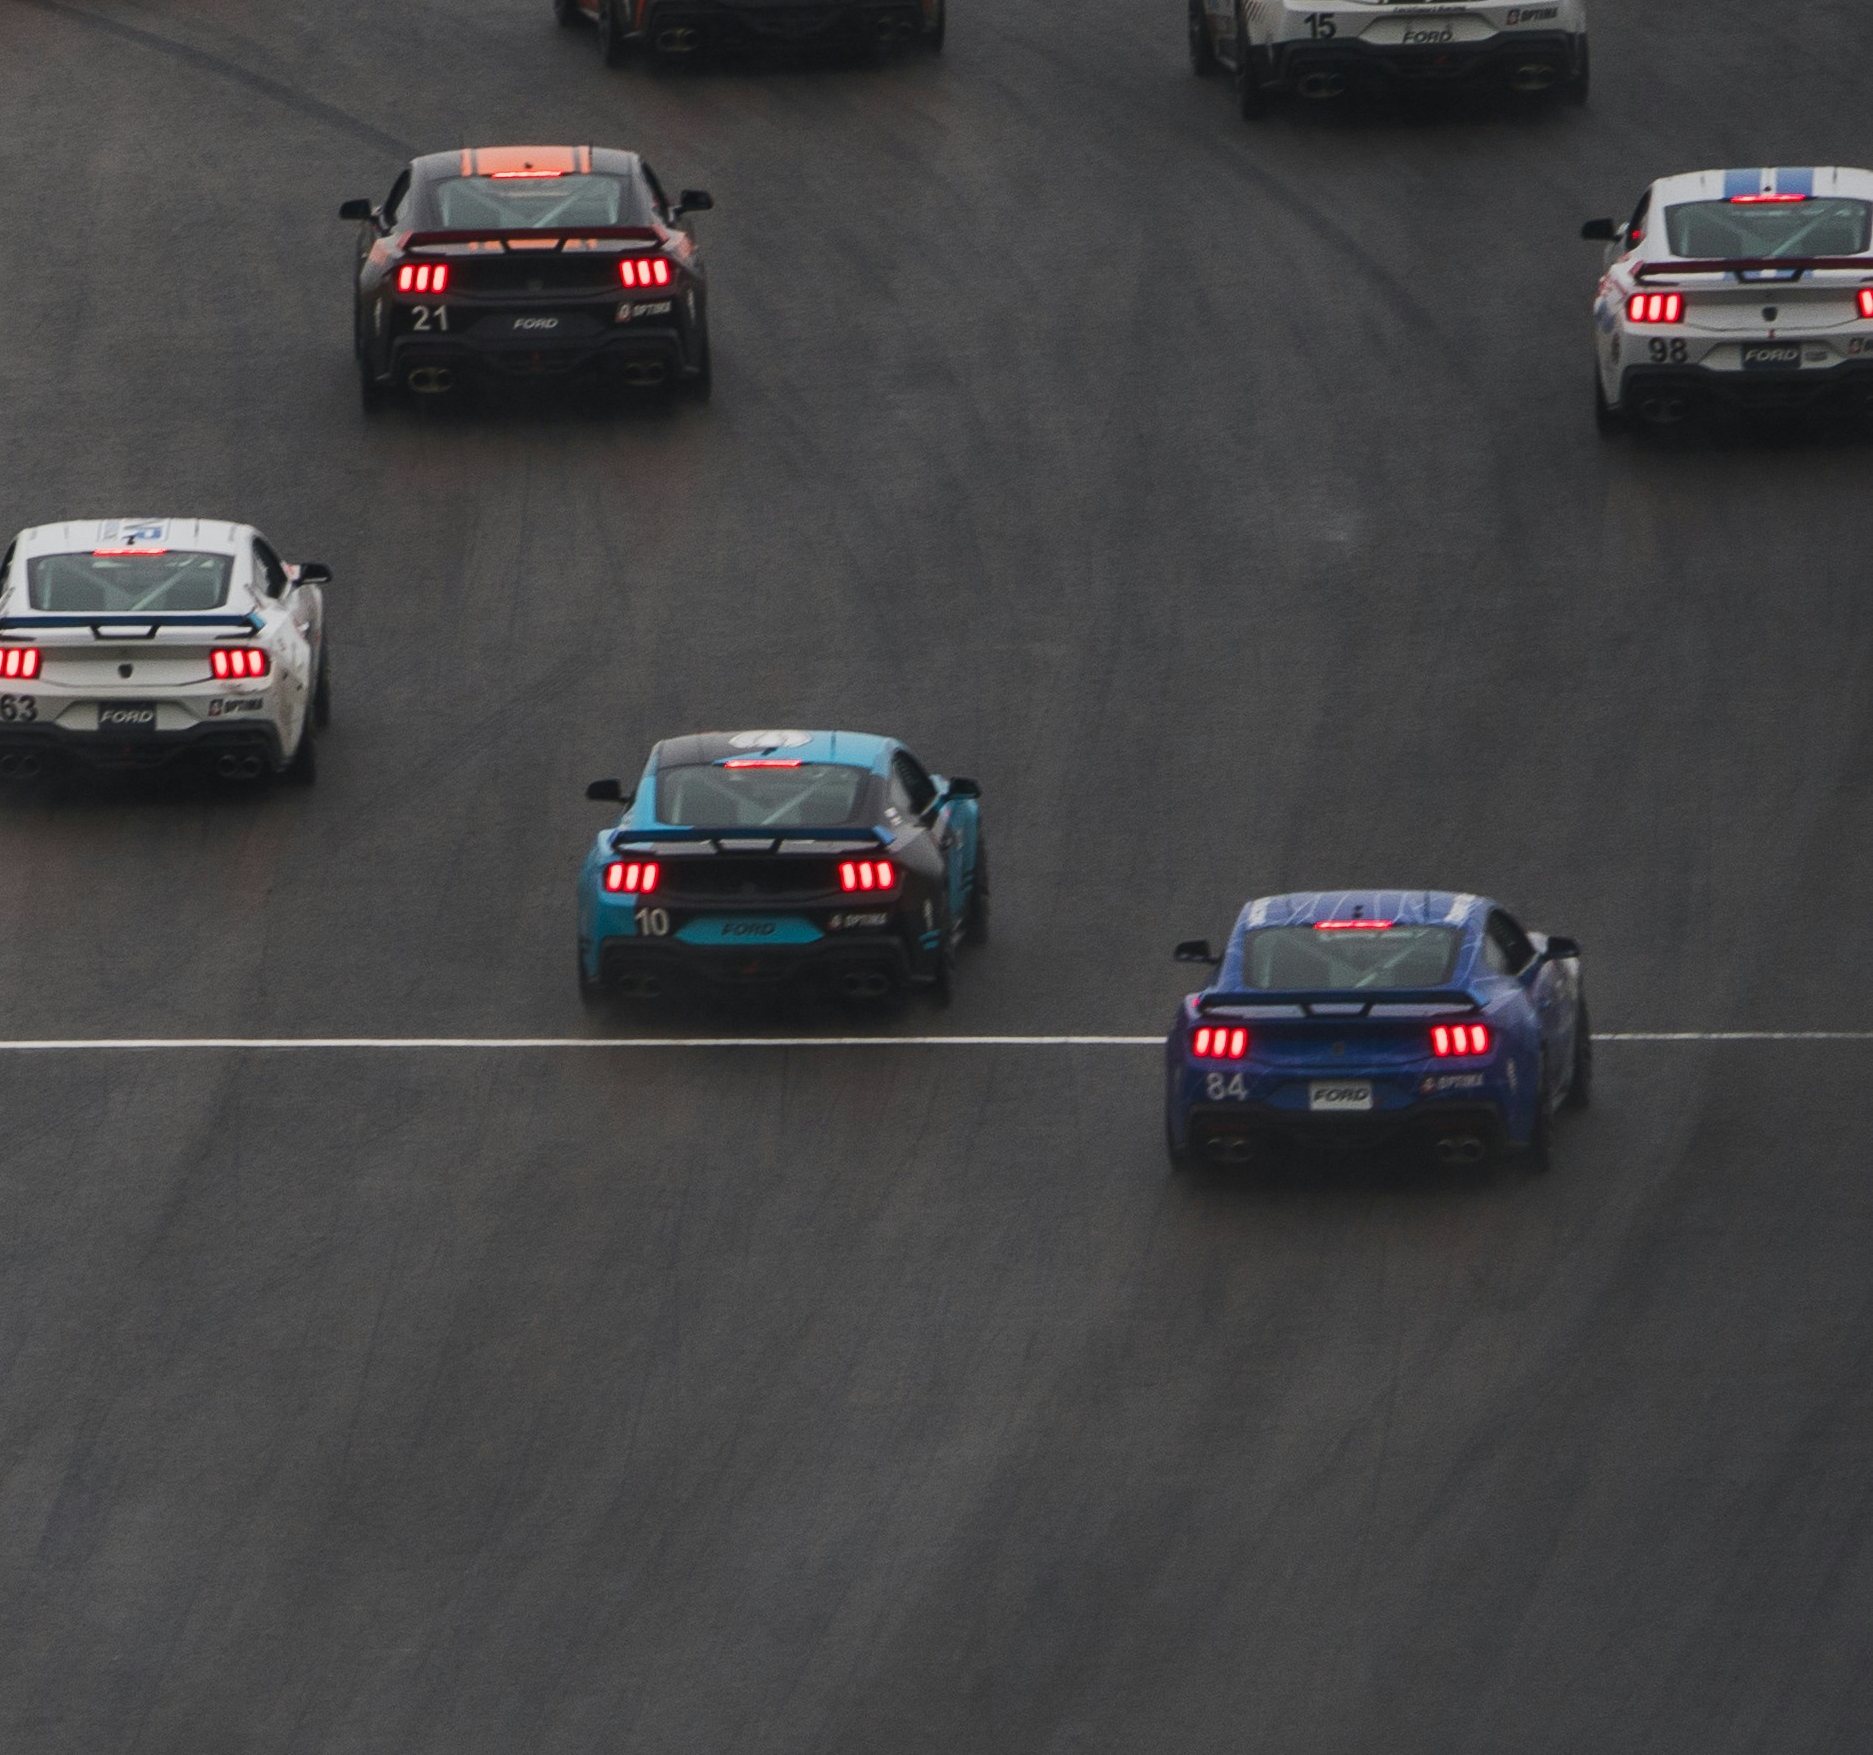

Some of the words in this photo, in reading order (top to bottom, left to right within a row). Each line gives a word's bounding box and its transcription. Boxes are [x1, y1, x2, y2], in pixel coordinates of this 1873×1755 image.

[1521, 7, 1558, 23] OPTIMA
[1304, 13, 1336, 39] 15
[1403, 30, 1453, 44] FORD
[631, 302, 671, 317] OPTIMA
[411, 305, 449, 331] 21
[513, 317, 559, 330] FORD
[1649, 337, 1688, 363] 98
[1745, 349, 1798, 362] FORD
[223, 698, 264, 714] OPTIMA
[101, 709, 153, 724] FORD
[635, 908, 669, 936] 10
[721, 922, 776, 937] FORD
[1206, 1073, 1249, 1101] 84
[1312, 1087, 1369, 1102] FORD
